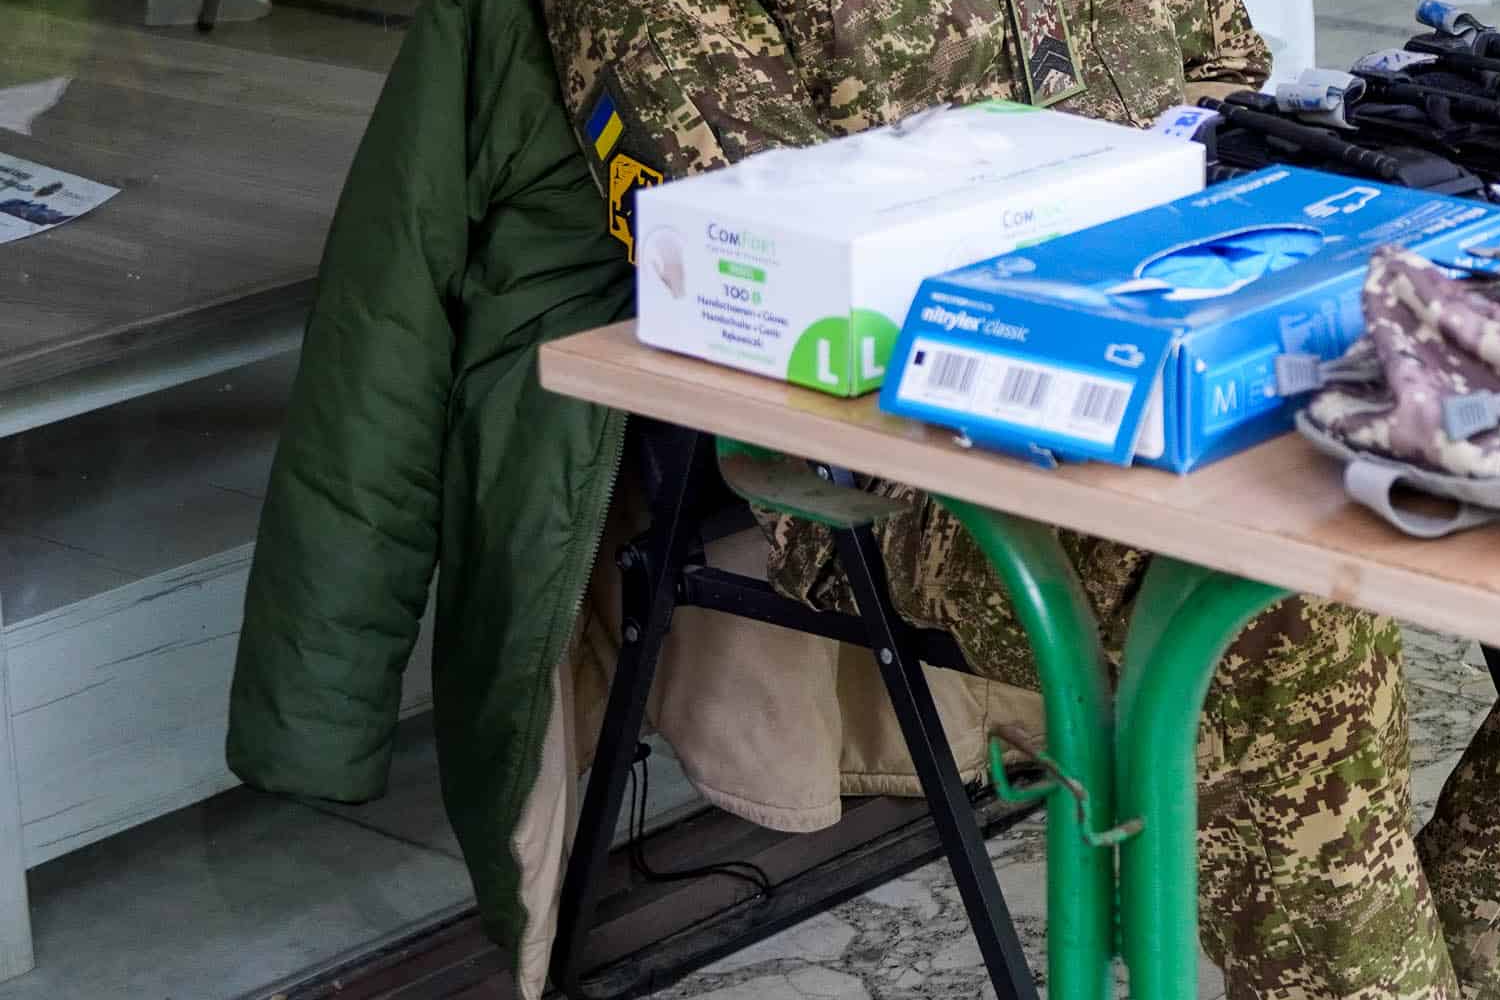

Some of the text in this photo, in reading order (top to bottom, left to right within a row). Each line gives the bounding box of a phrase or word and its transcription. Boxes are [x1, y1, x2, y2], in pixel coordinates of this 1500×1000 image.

[982, 317, 1030, 342] classic
[817, 339, 838, 384] L
[860, 335, 885, 378] L
[1214, 381, 1238, 417] M
